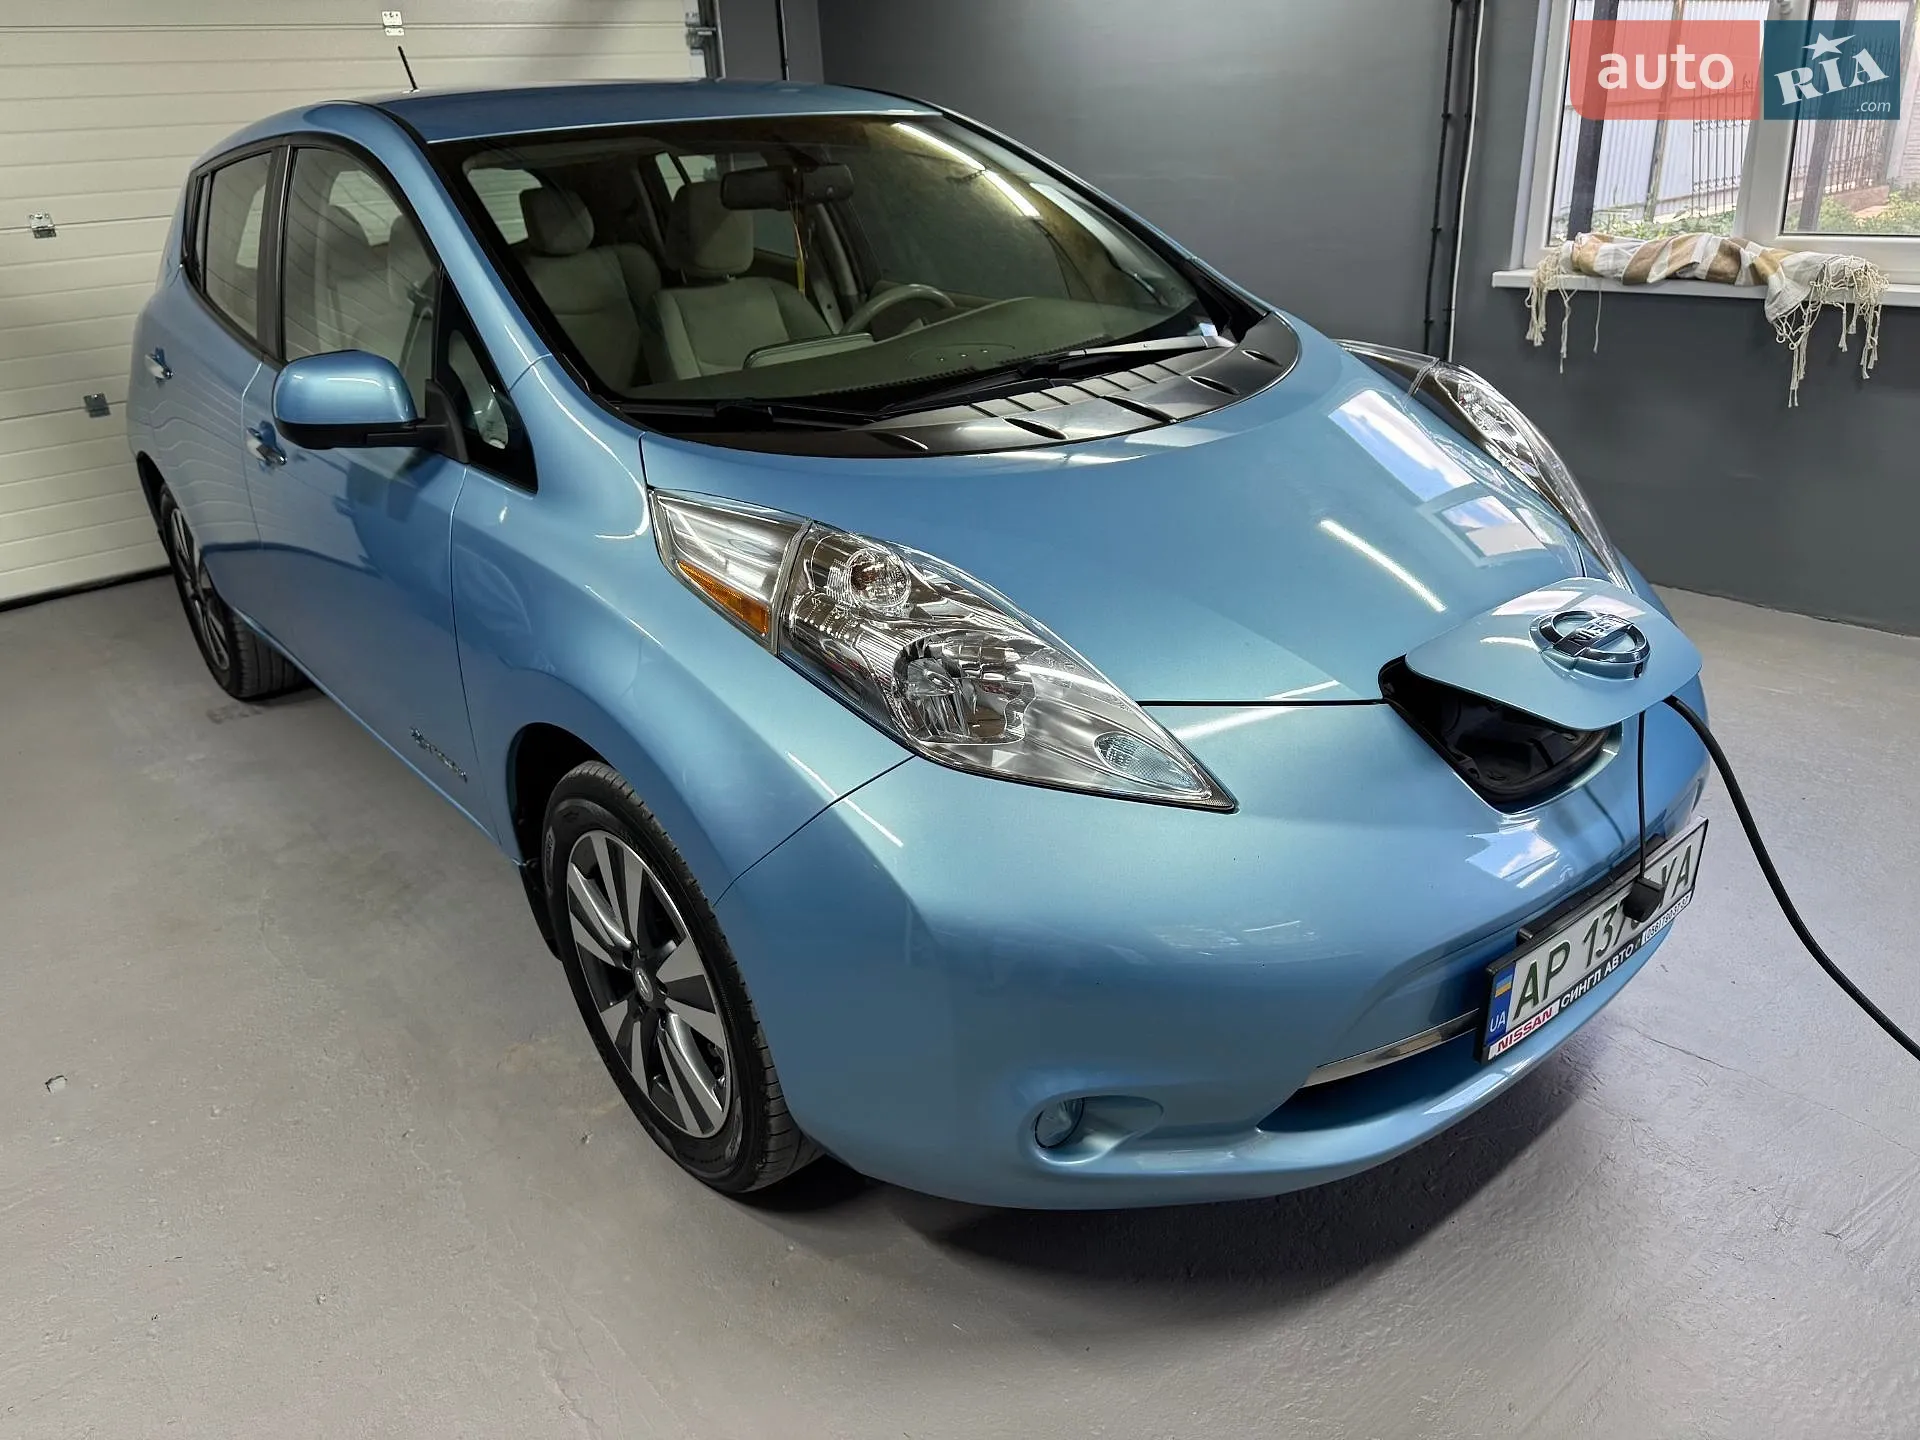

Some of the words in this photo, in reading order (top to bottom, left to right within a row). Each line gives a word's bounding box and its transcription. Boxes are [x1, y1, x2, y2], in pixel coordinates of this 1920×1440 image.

[1513, 940, 1571, 1021] AP
[1583, 880, 1650, 969] 137
[1604, 943, 1634, 976] АВТО
[1490, 1011, 1506, 1033] UA
[1497, 1007, 1553, 1051] NISSAN
